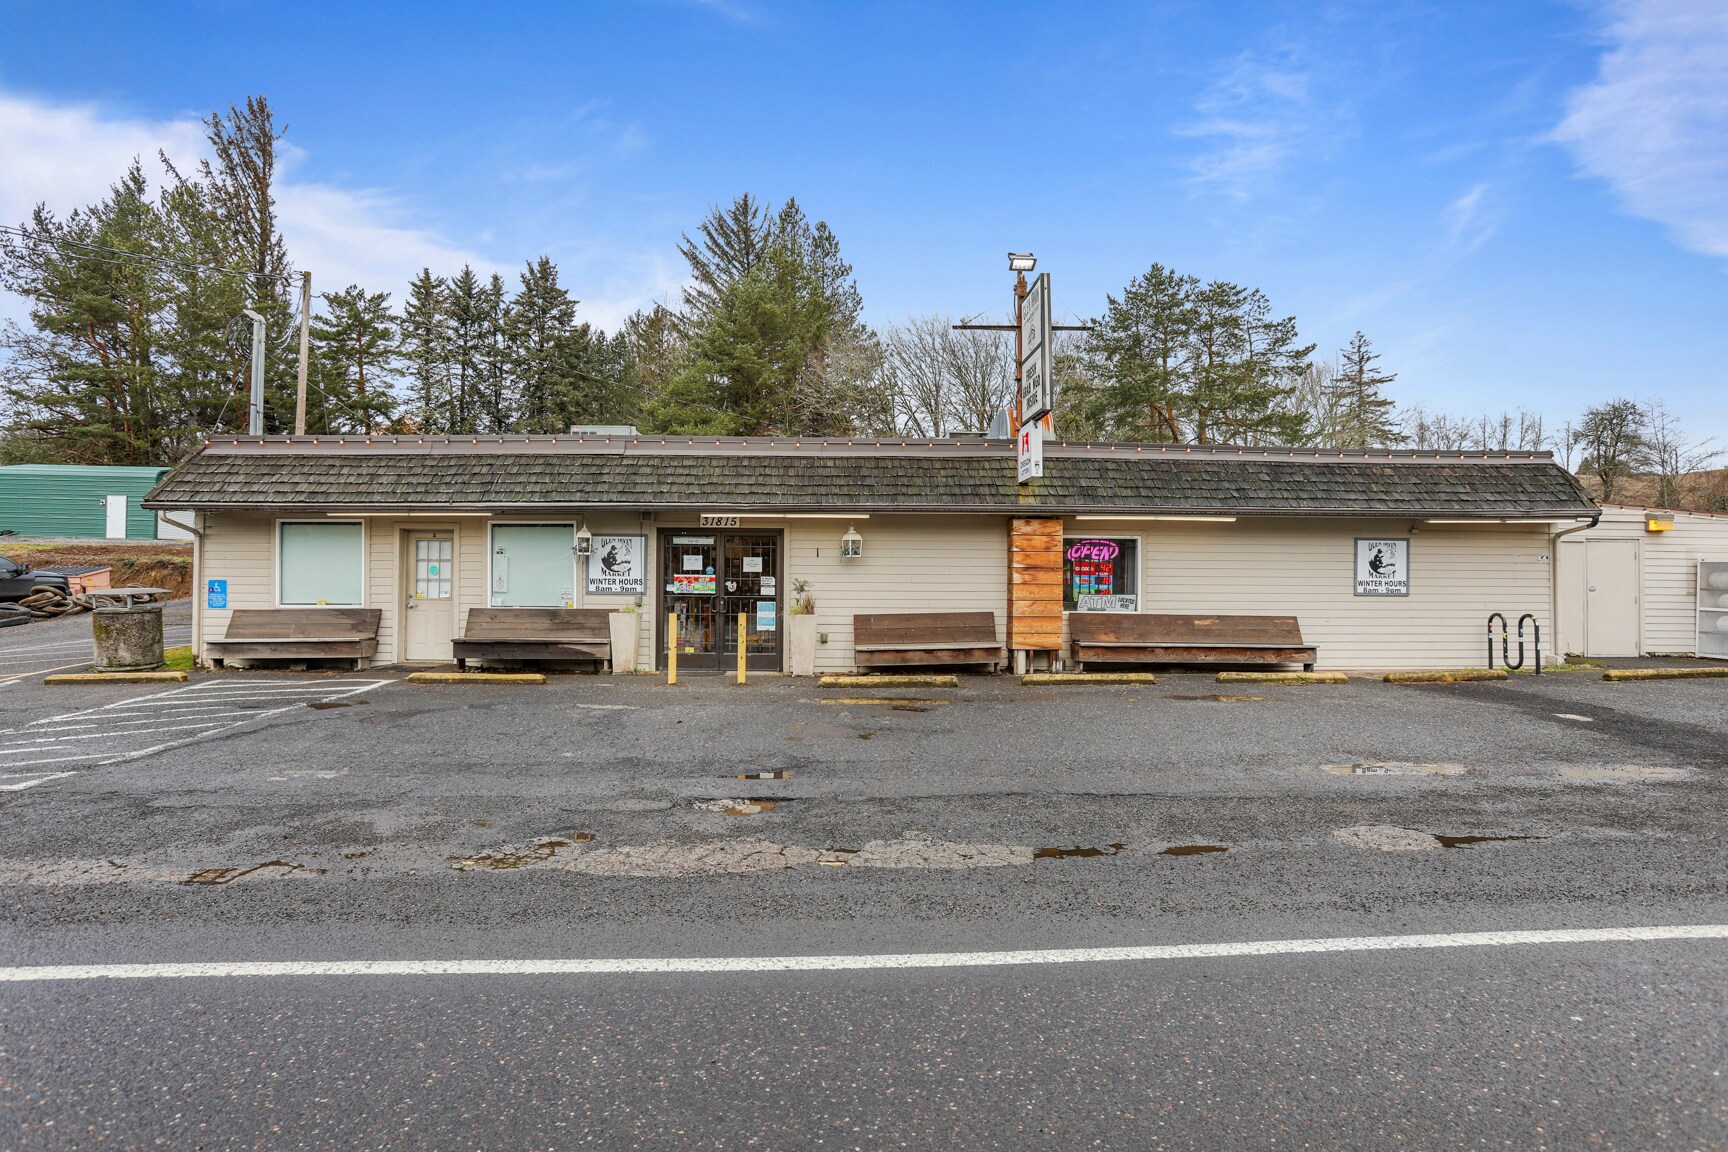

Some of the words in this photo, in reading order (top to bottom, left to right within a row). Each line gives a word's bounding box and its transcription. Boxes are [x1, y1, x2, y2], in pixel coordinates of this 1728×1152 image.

[702, 516, 737, 527] 31815
[1071, 544, 1113, 560] OPEN
[601, 566, 631, 576] MARKET
[1368, 569, 1396, 578] MARKET
[619, 578, 643, 586] HOURS
[1079, 595, 1117, 608] ATM
